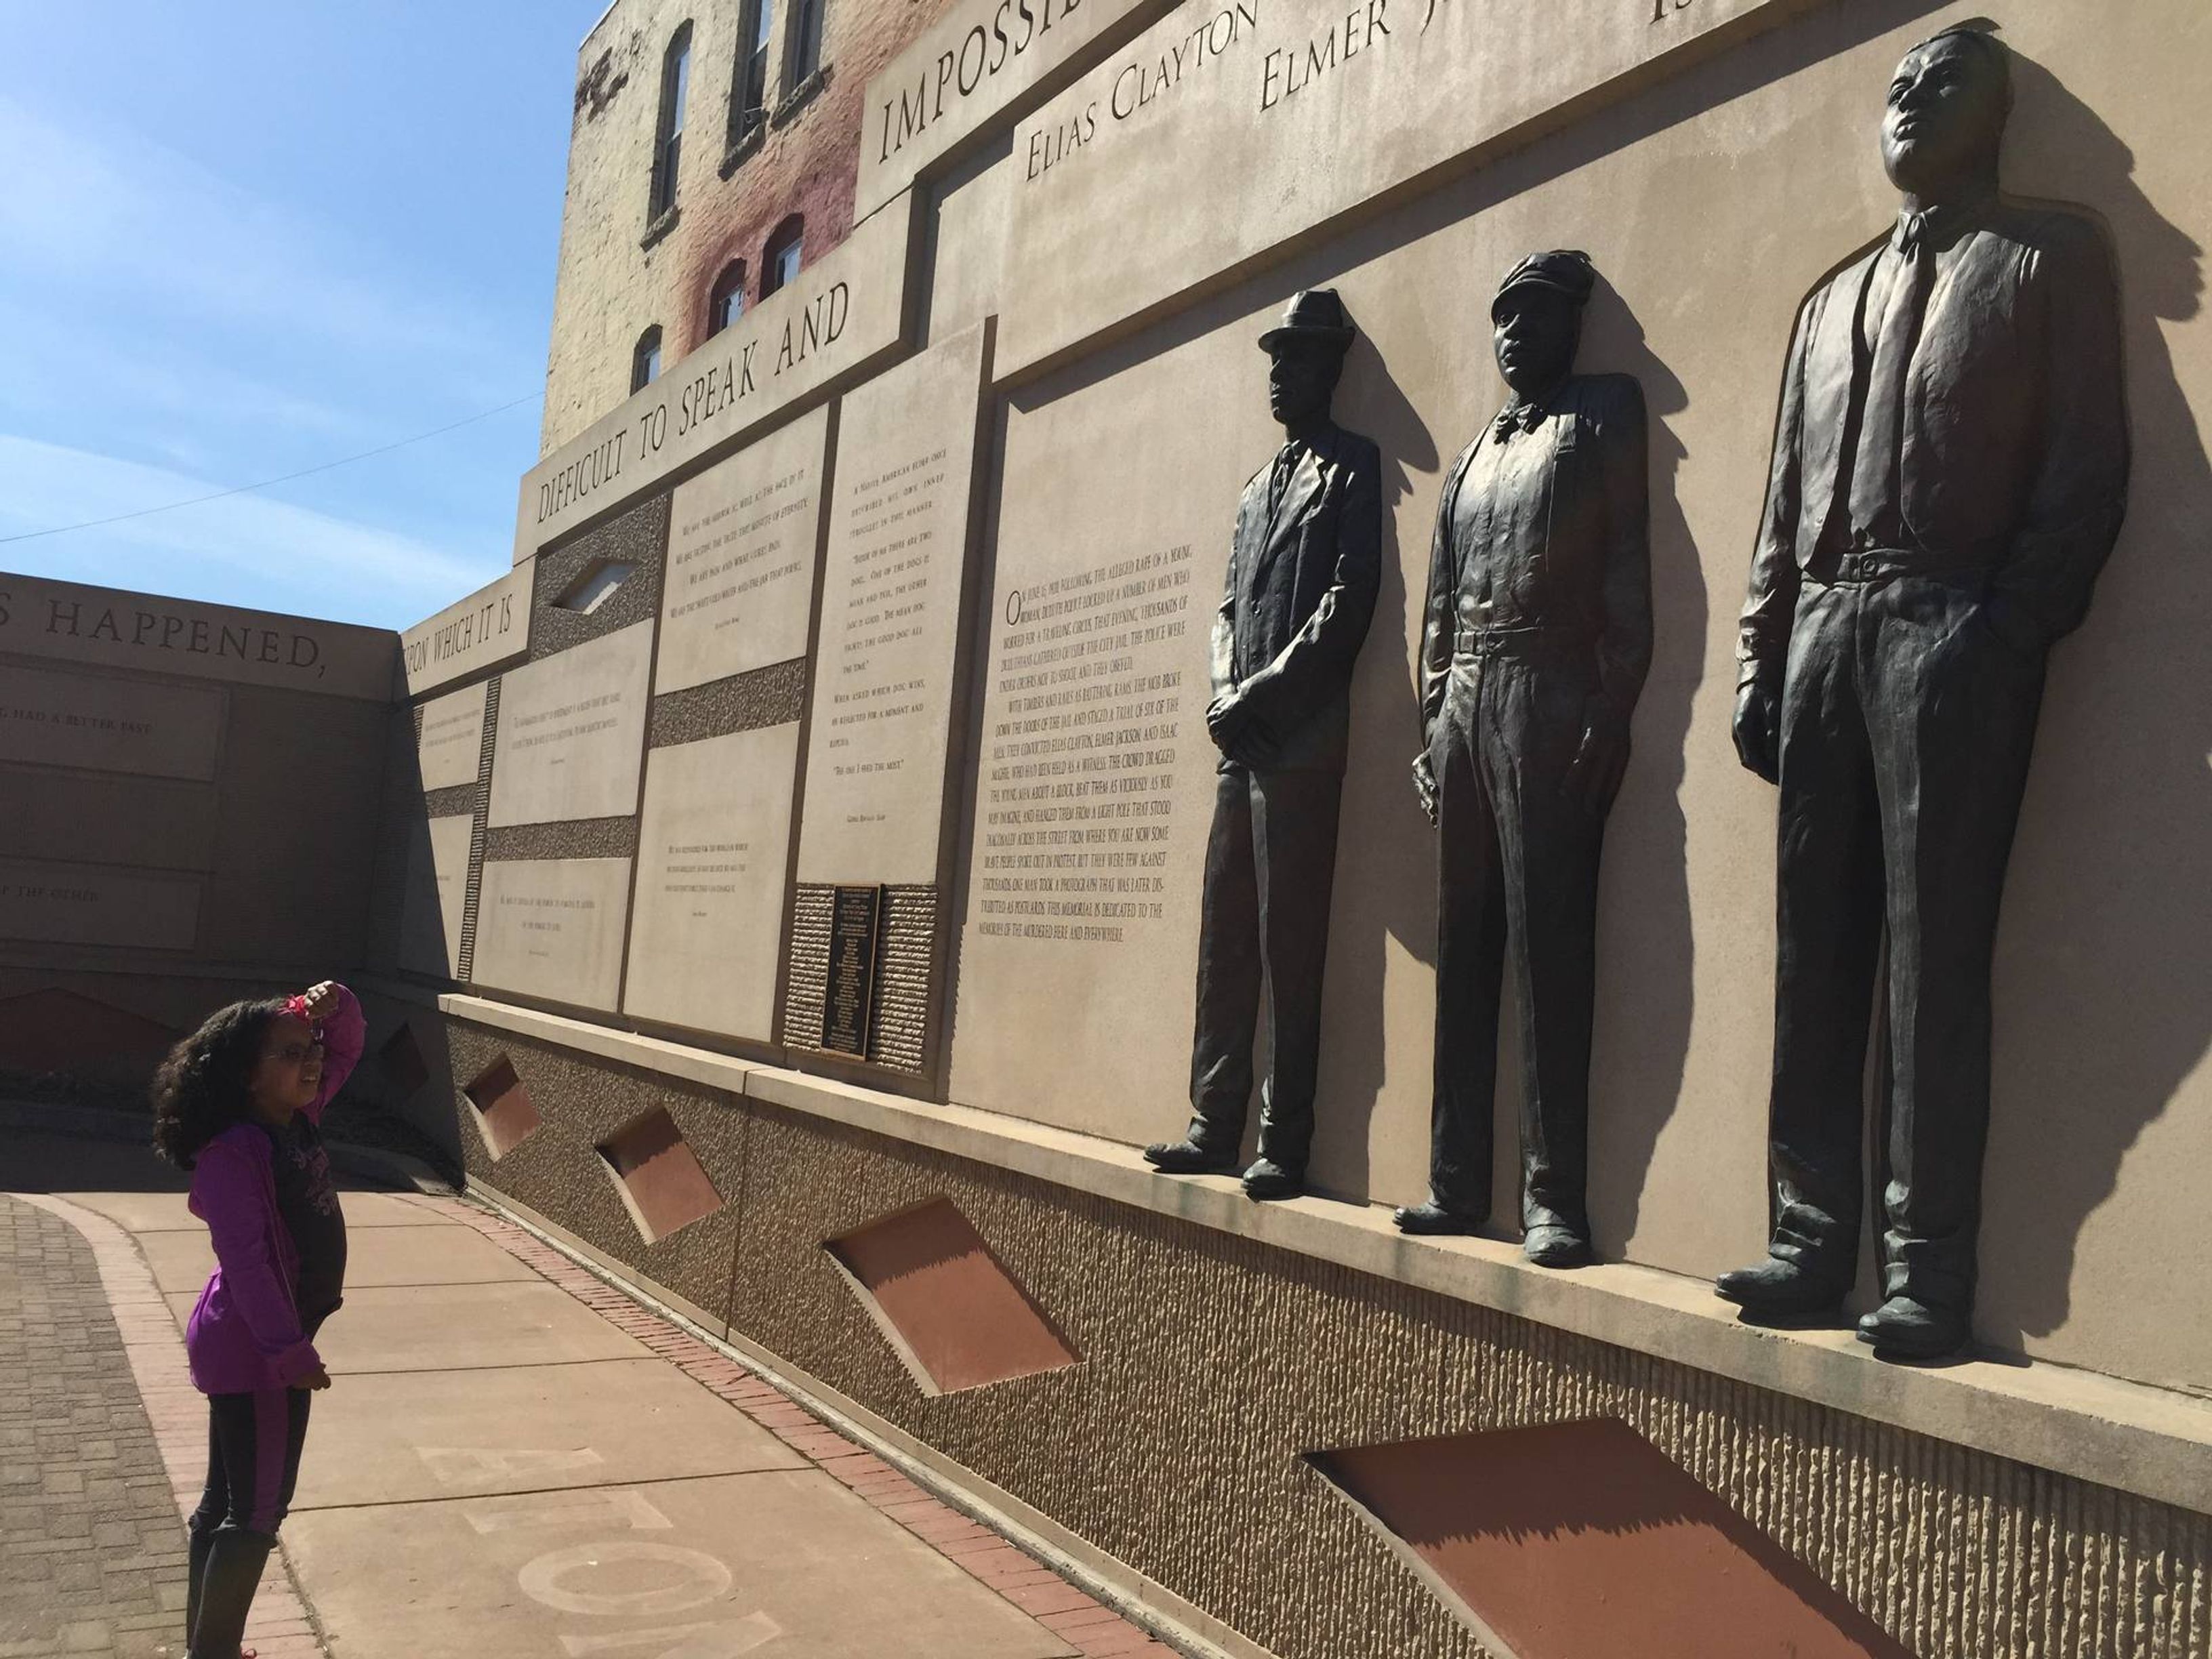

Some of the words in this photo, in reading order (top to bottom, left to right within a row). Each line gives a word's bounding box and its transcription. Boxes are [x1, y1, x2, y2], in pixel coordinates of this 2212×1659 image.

[1027, 102, 1097, 182] ELIAS
[1111, 0, 1258, 121] CLAYTON
[1261, 0, 1391, 112] ELMER
[537, 429, 627, 524] DIFFICULT
[640, 404, 668, 460] TO
[679, 340, 758, 436] SPEAK
[775, 281, 848, 375] AND
[46, 599, 325, 678] HAPPENED,
[434, 614, 474, 662] WHICH
[478, 603, 494, 644] IT
[499, 594, 513, 634] IS
[14, 708, 45, 722] HAD
[51, 714, 60, 724] A
